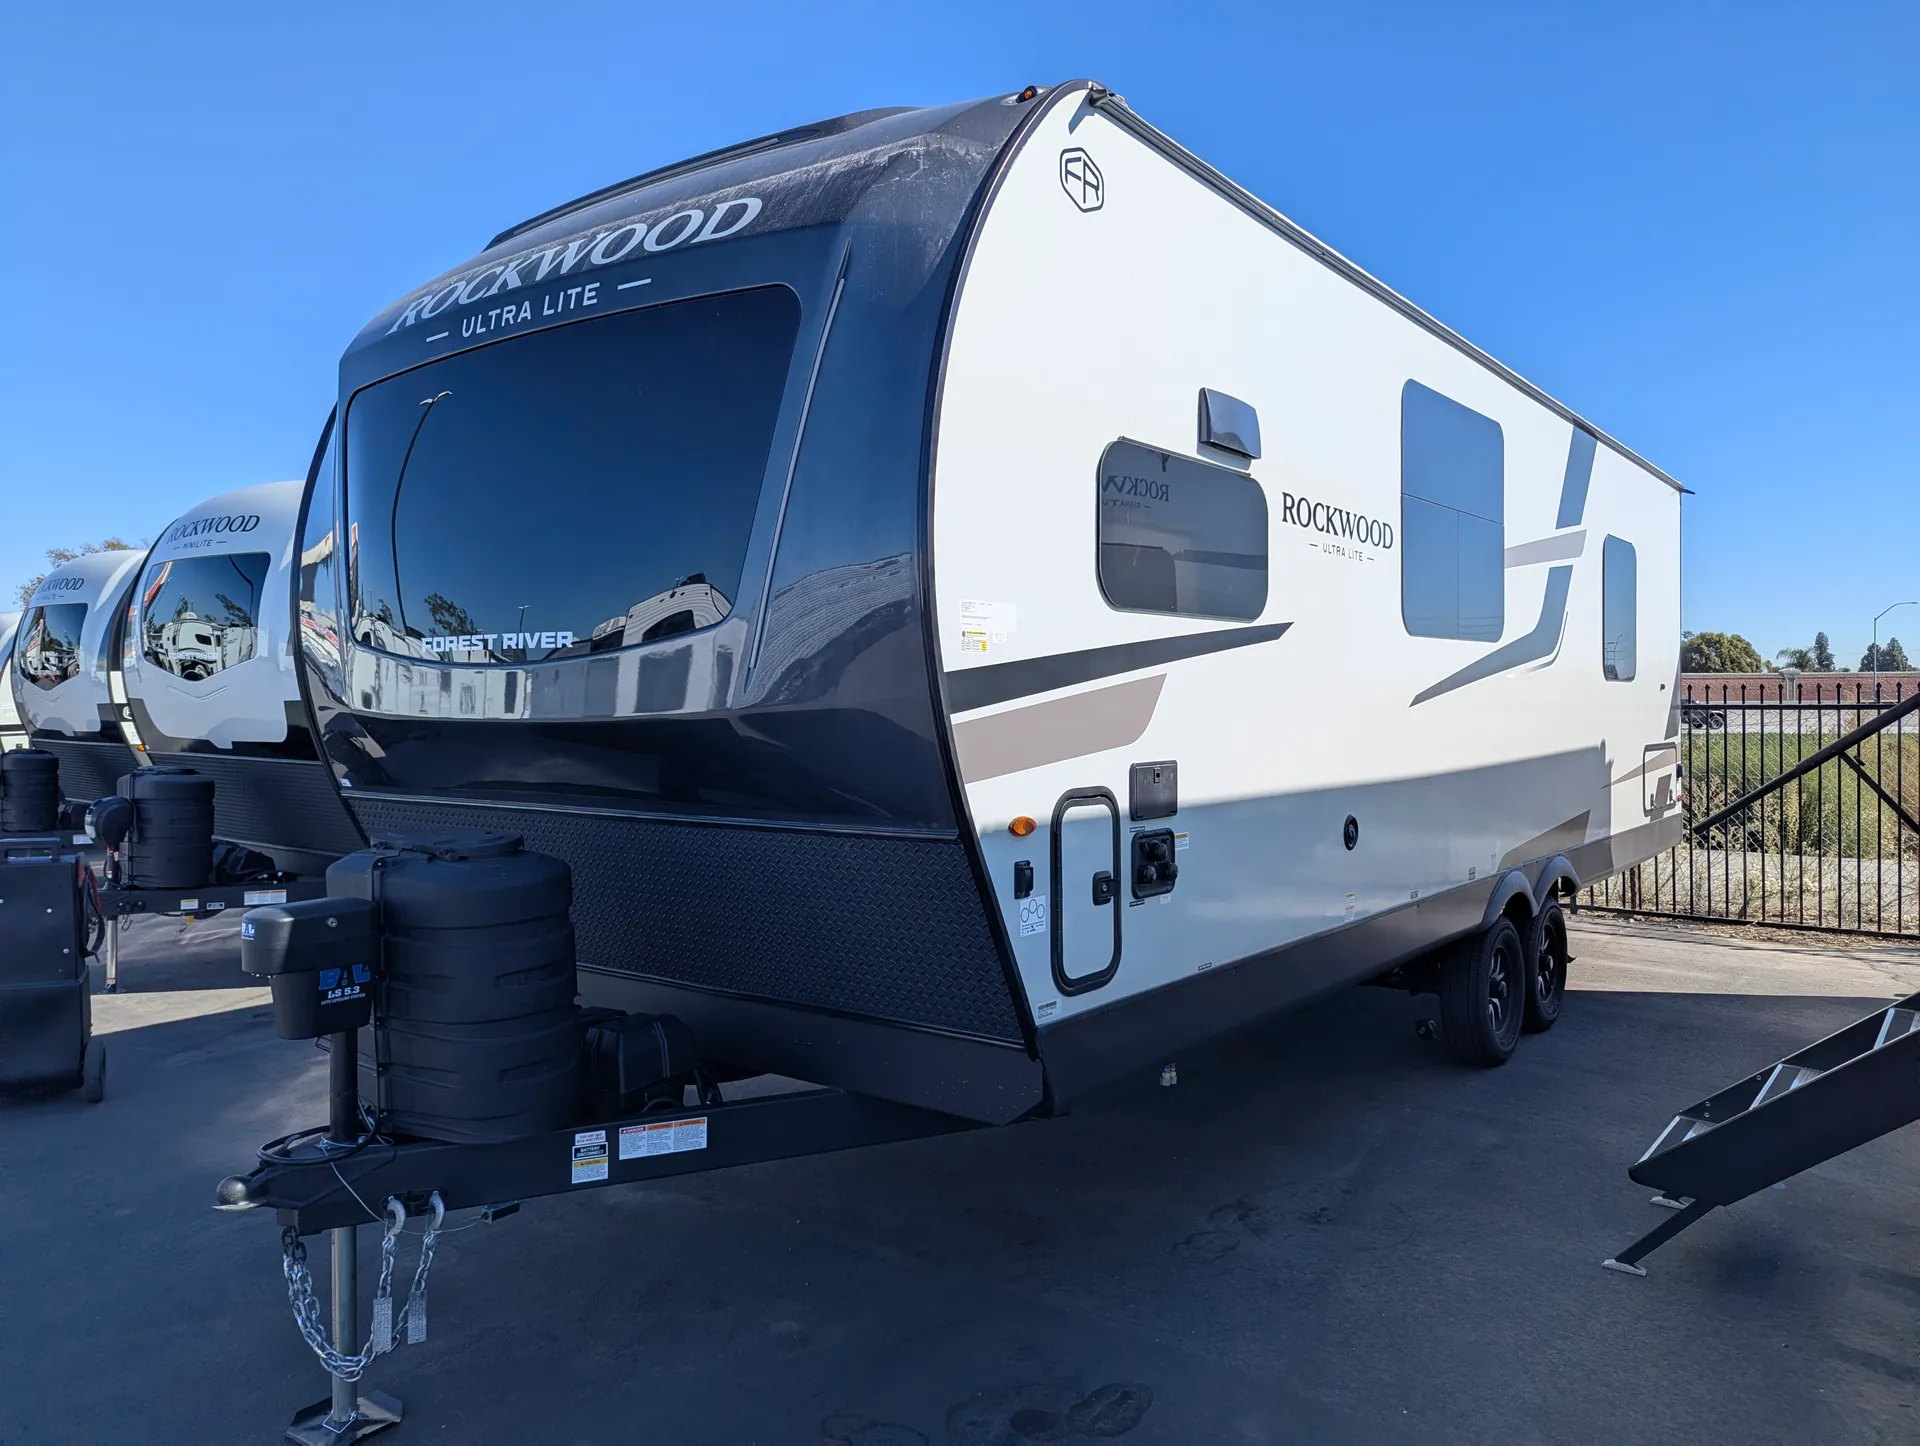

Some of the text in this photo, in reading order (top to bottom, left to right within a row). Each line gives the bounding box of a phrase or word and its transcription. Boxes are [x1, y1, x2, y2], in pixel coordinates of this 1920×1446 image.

[385, 197, 763, 336] ROCKWOOD
[461, 282, 601, 338] ULTRA LITE
[165, 514, 261, 545] ROCKWOOD
[1281, 492, 1394, 550] ROCKWOOD
[1322, 542, 1363, 562] ULTRA LITE
[421, 631, 574, 653] FOREST RIVER
[328, 989, 342, 999] LS
